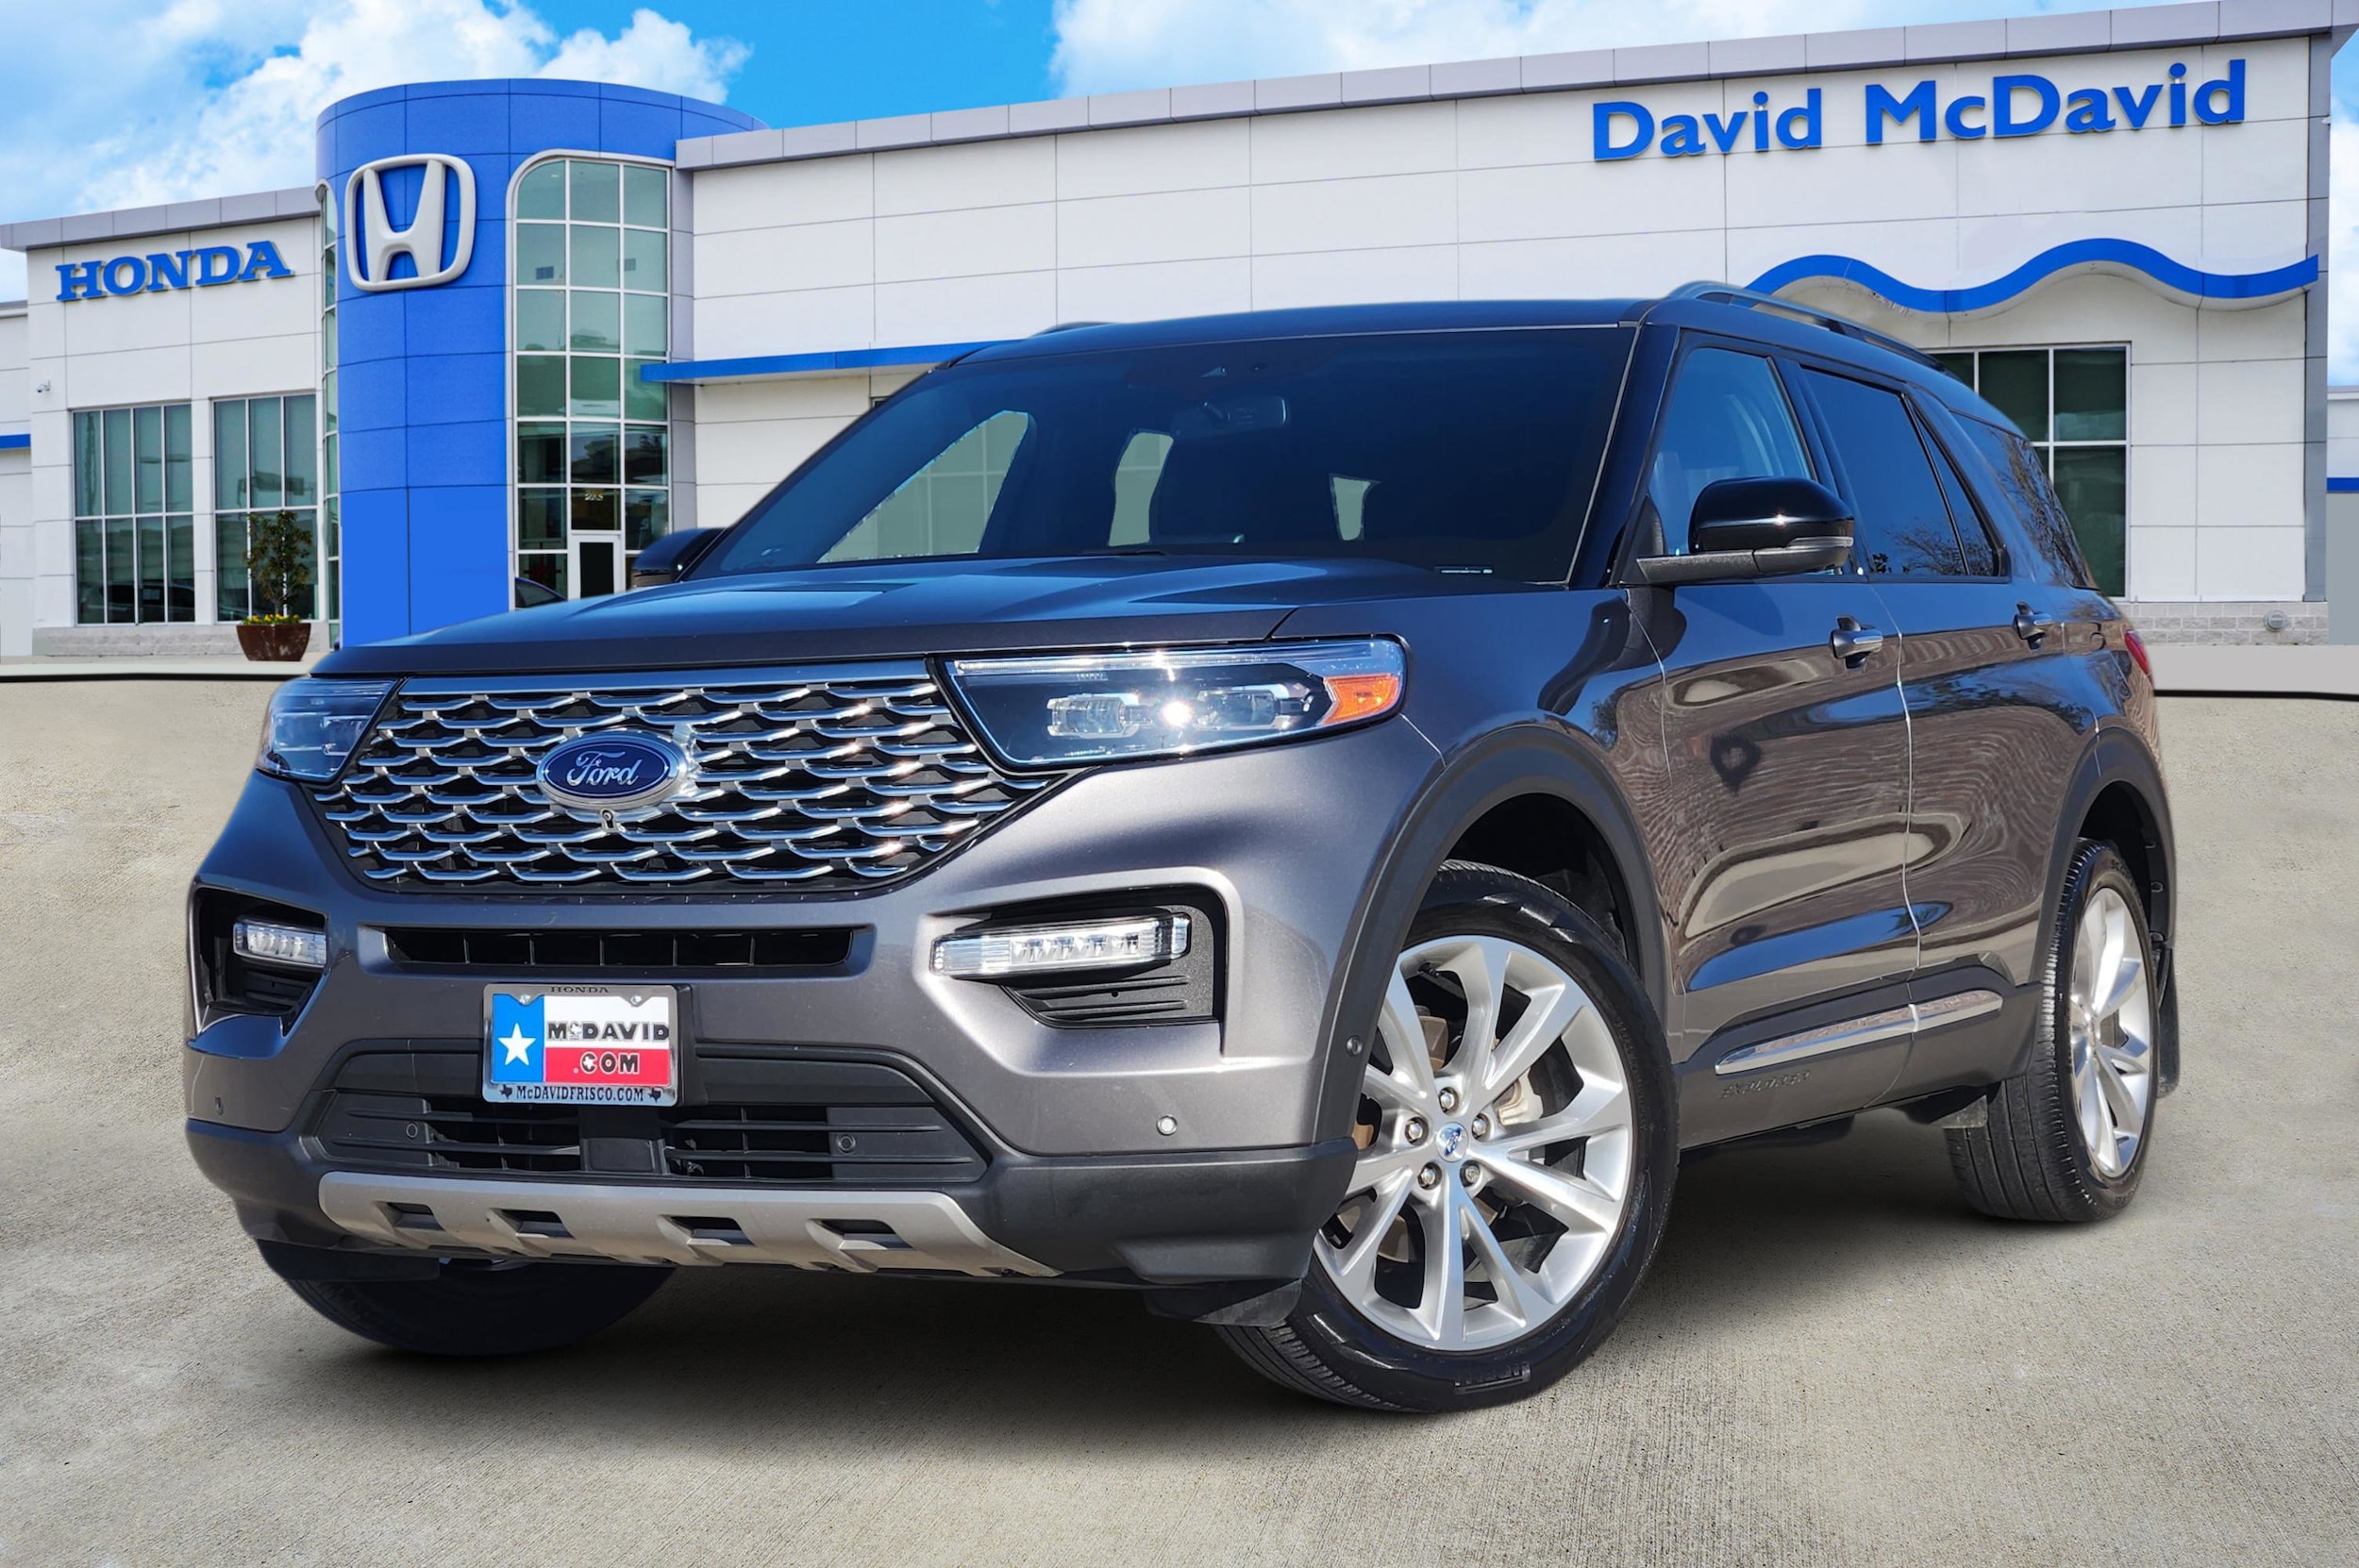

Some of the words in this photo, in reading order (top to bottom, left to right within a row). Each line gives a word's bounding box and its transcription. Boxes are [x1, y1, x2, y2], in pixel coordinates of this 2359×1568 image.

[1593, 88, 1822, 161] David
[1865, 58, 2247, 144] McDavid
[56, 241, 293, 302] HONDA
[566, 750, 643, 787] Ford
[574, 1051, 640, 1075] .COM
[516, 1085, 644, 1102] McDAVIDFRISCO.COM
